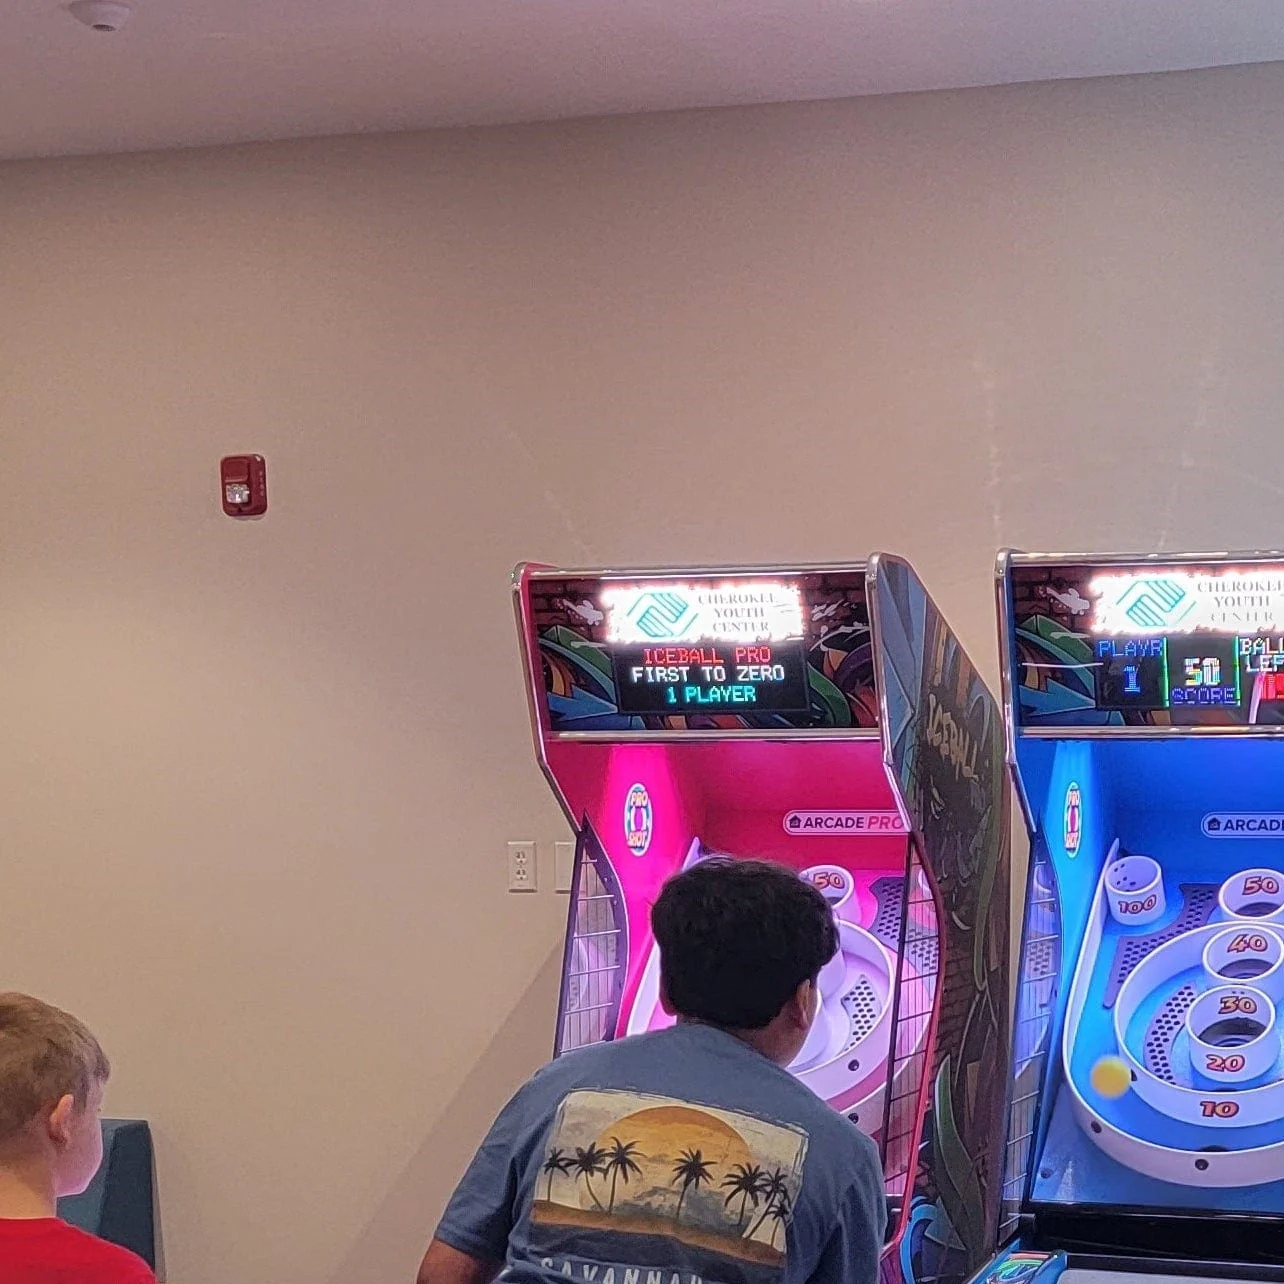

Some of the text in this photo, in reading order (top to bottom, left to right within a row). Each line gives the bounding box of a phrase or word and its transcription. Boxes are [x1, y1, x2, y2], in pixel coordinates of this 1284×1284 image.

[1214, 595, 1270, 607] YOUTH
[714, 607, 765, 618] YOUTH
[1210, 611, 1274, 622] CENTER
[712, 621, 769, 633] CENTER
[643, 646, 771, 664] ICEBALL PRO
[631, 664, 785, 683] FIRST TO ZERO
[1123, 665, 1140, 693] 1
[1184, 657, 1220, 687] 50
[667, 685, 757, 703] 1 PLAYER
[1171, 688, 1236, 704] SCORE
[803, 815, 903, 829] ARCADE PRO
[811, 871, 845, 889] 50
[1242, 876, 1279, 895] 50
[1118, 894, 1157, 914] 100
[1227, 934, 1267, 953] 40
[1218, 996, 1257, 1015] 30
[1206, 1055, 1245, 1072] 20
[1200, 1101, 1239, 1118] 10
